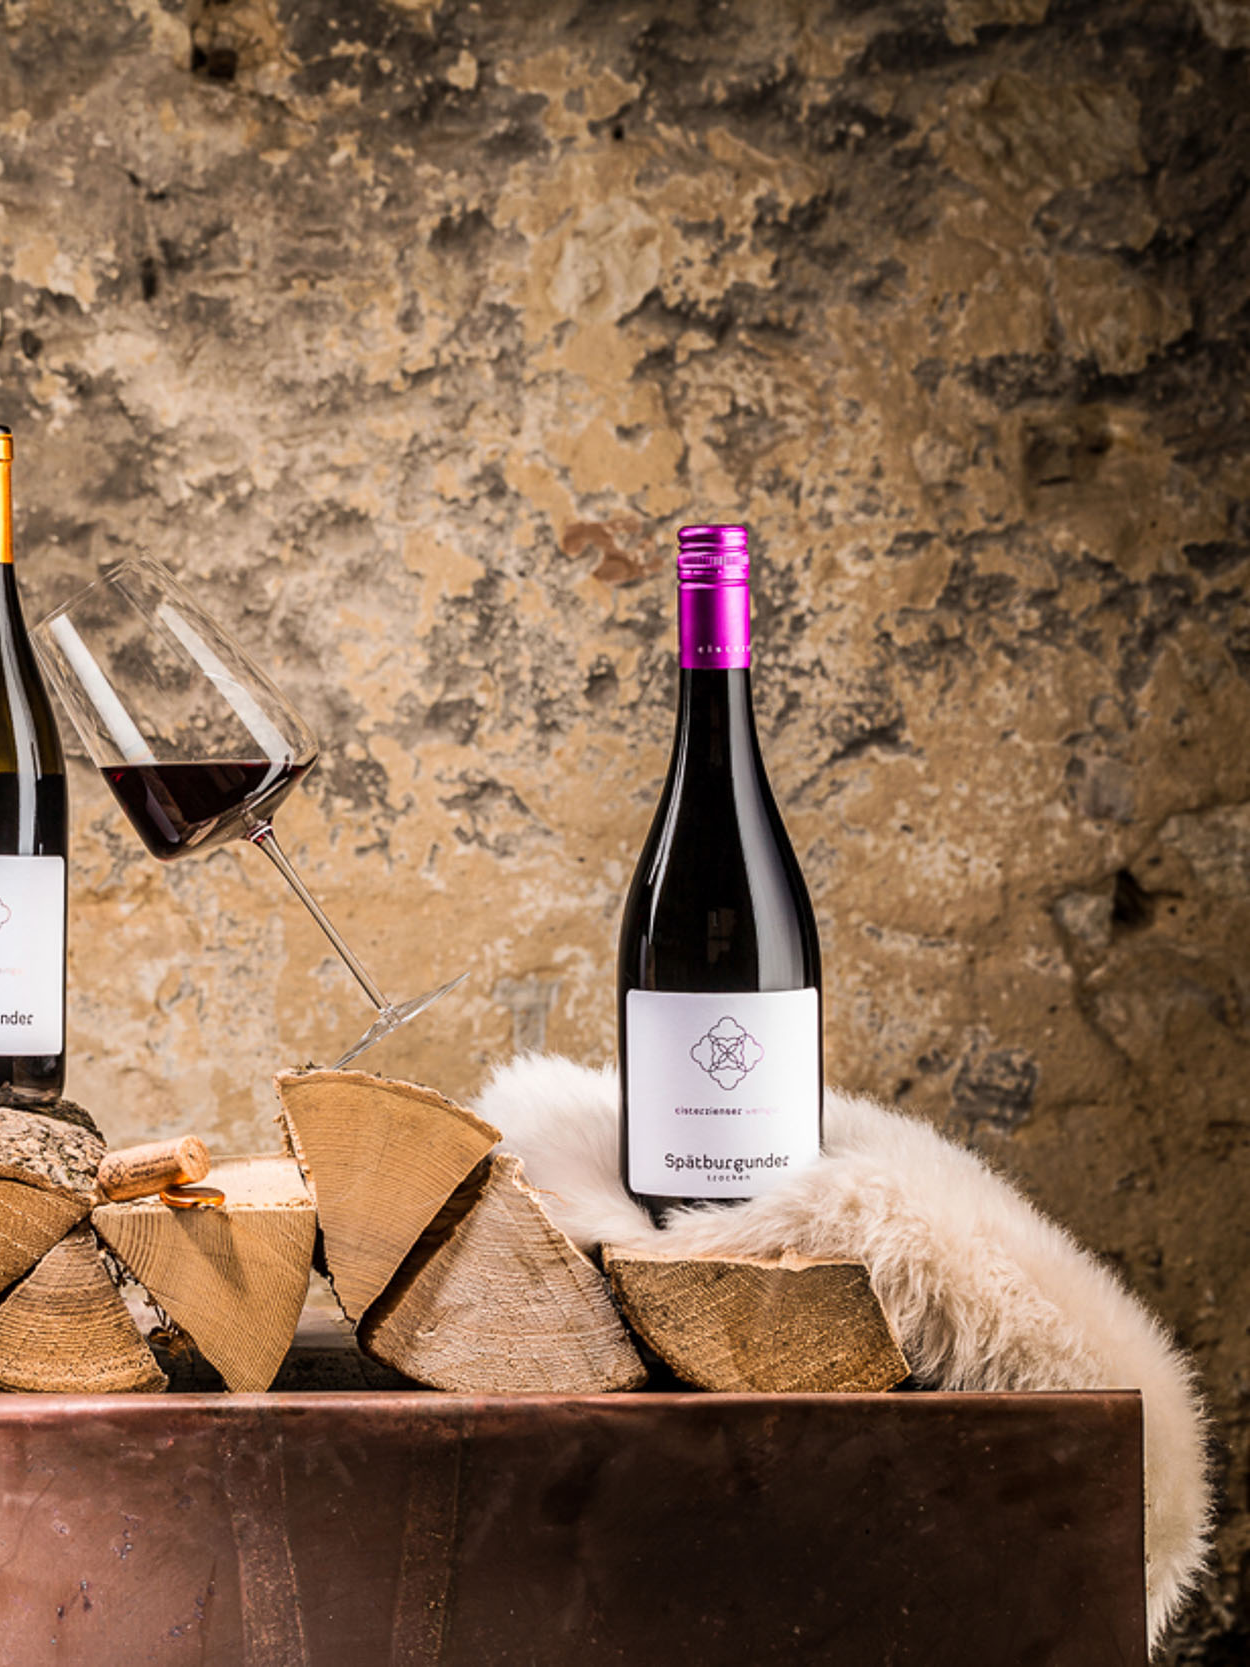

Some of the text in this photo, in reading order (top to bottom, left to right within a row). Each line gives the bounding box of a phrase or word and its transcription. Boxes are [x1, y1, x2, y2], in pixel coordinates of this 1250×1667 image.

[674, 1106, 742, 1116] cisterzienser
[664, 1152, 790, 1174] Spätburgunder
[707, 1173, 751, 1182] trocken
